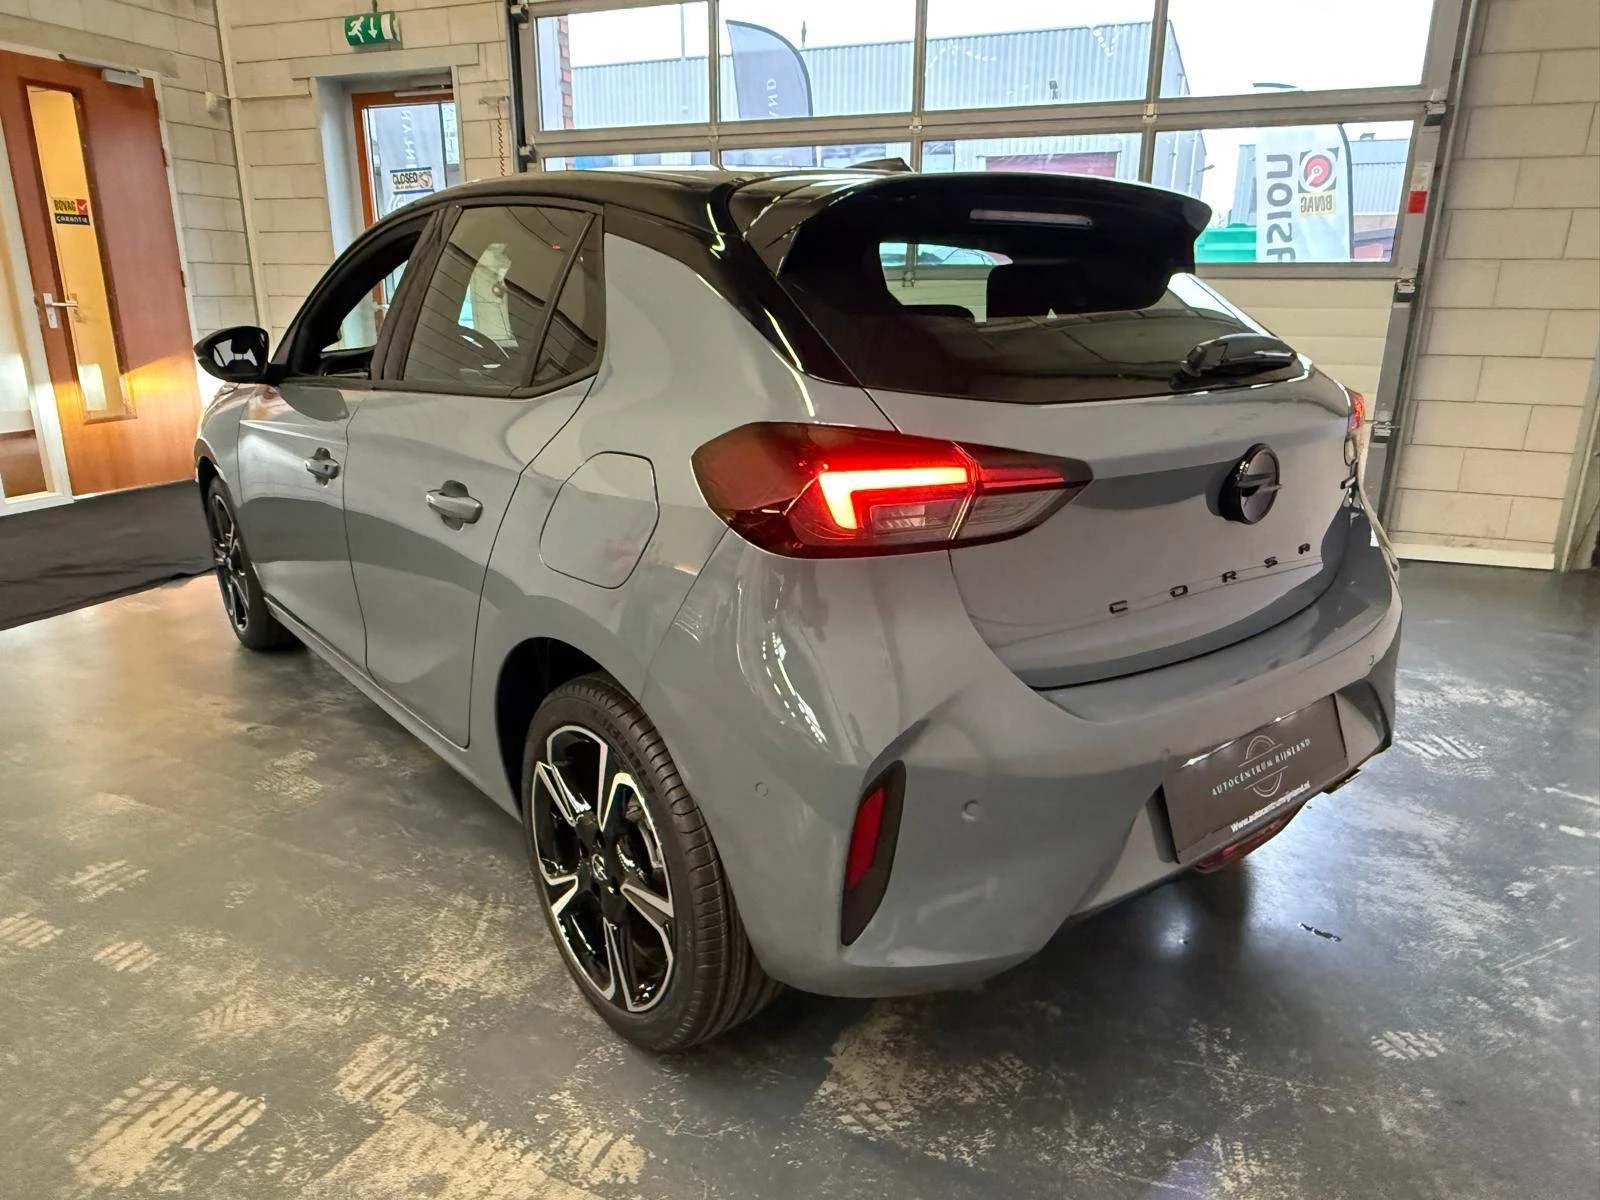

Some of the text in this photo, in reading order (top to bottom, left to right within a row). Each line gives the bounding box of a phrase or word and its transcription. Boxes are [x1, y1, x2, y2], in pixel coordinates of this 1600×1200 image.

[392, 171, 418, 185] CLOSED
[54, 199, 76, 211] BOVAG
[1108, 543, 1311, 614] CORSA
[1211, 738, 1311, 796] AUTOCENTRUM RIJNLAND
